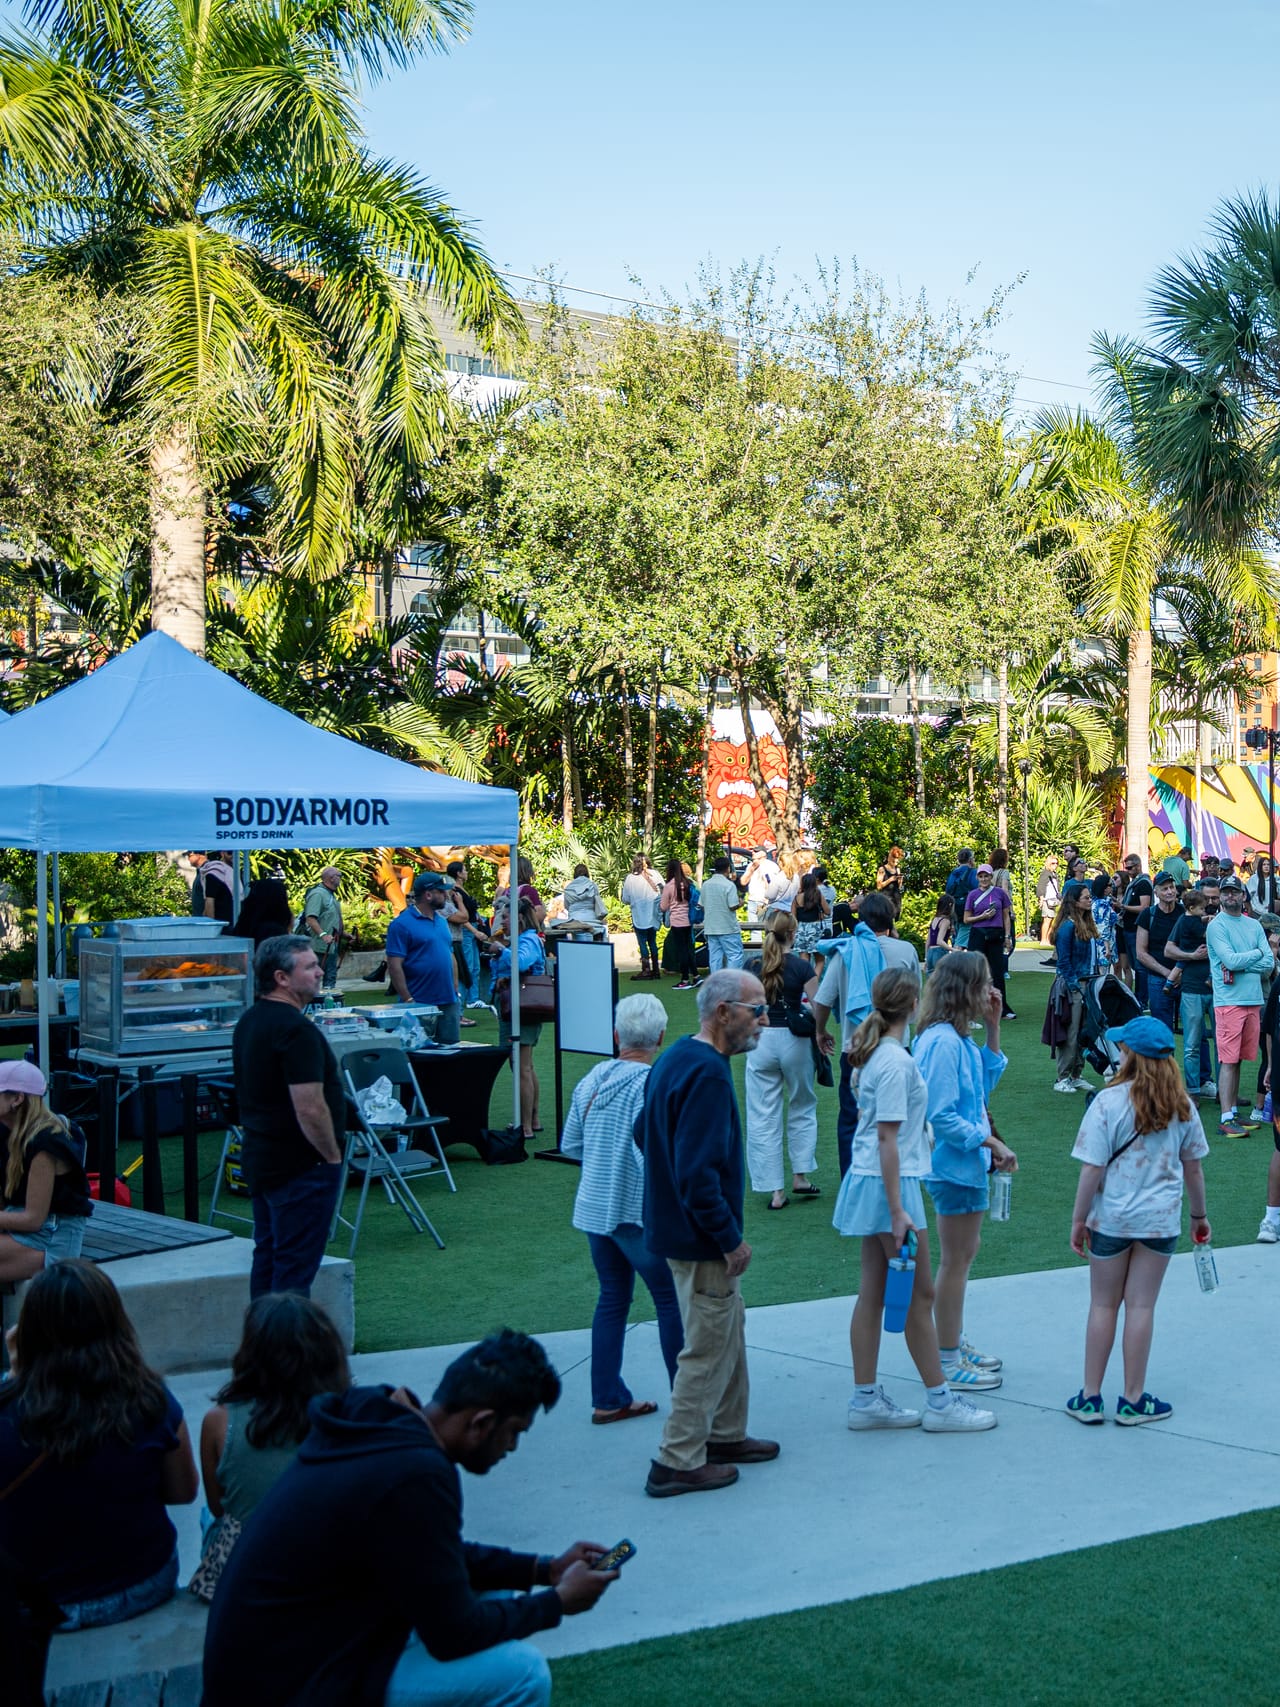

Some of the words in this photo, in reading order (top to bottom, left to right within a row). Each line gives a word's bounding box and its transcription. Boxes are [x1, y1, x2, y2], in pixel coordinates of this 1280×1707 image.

[213, 797, 390, 826] BODYARMOR
[216, 830, 259, 840] SPORTS
[261, 830, 294, 839] DRINK
